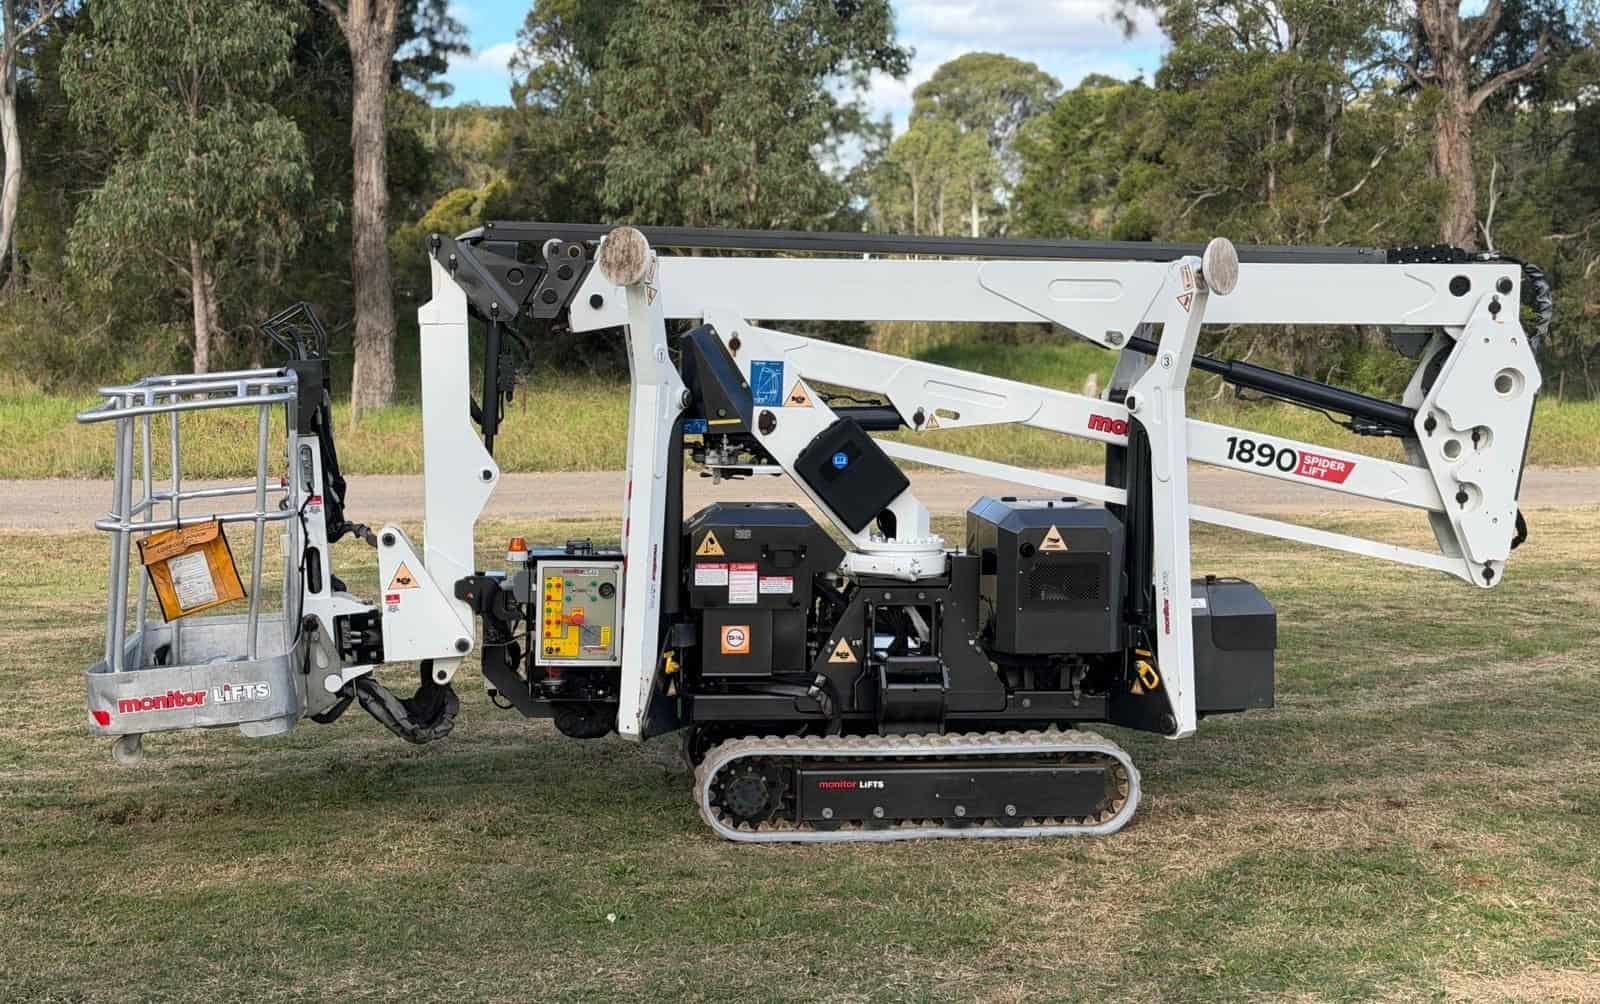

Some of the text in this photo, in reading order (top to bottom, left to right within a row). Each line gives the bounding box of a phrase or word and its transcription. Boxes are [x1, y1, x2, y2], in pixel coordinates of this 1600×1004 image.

[1226, 436, 1297, 472] 1890
[1301, 465, 1328, 478] LIFT
[1303, 455, 1346, 472] SPIDER
[119, 691, 206, 714] monitor
[819, 780, 857, 789] monitor
